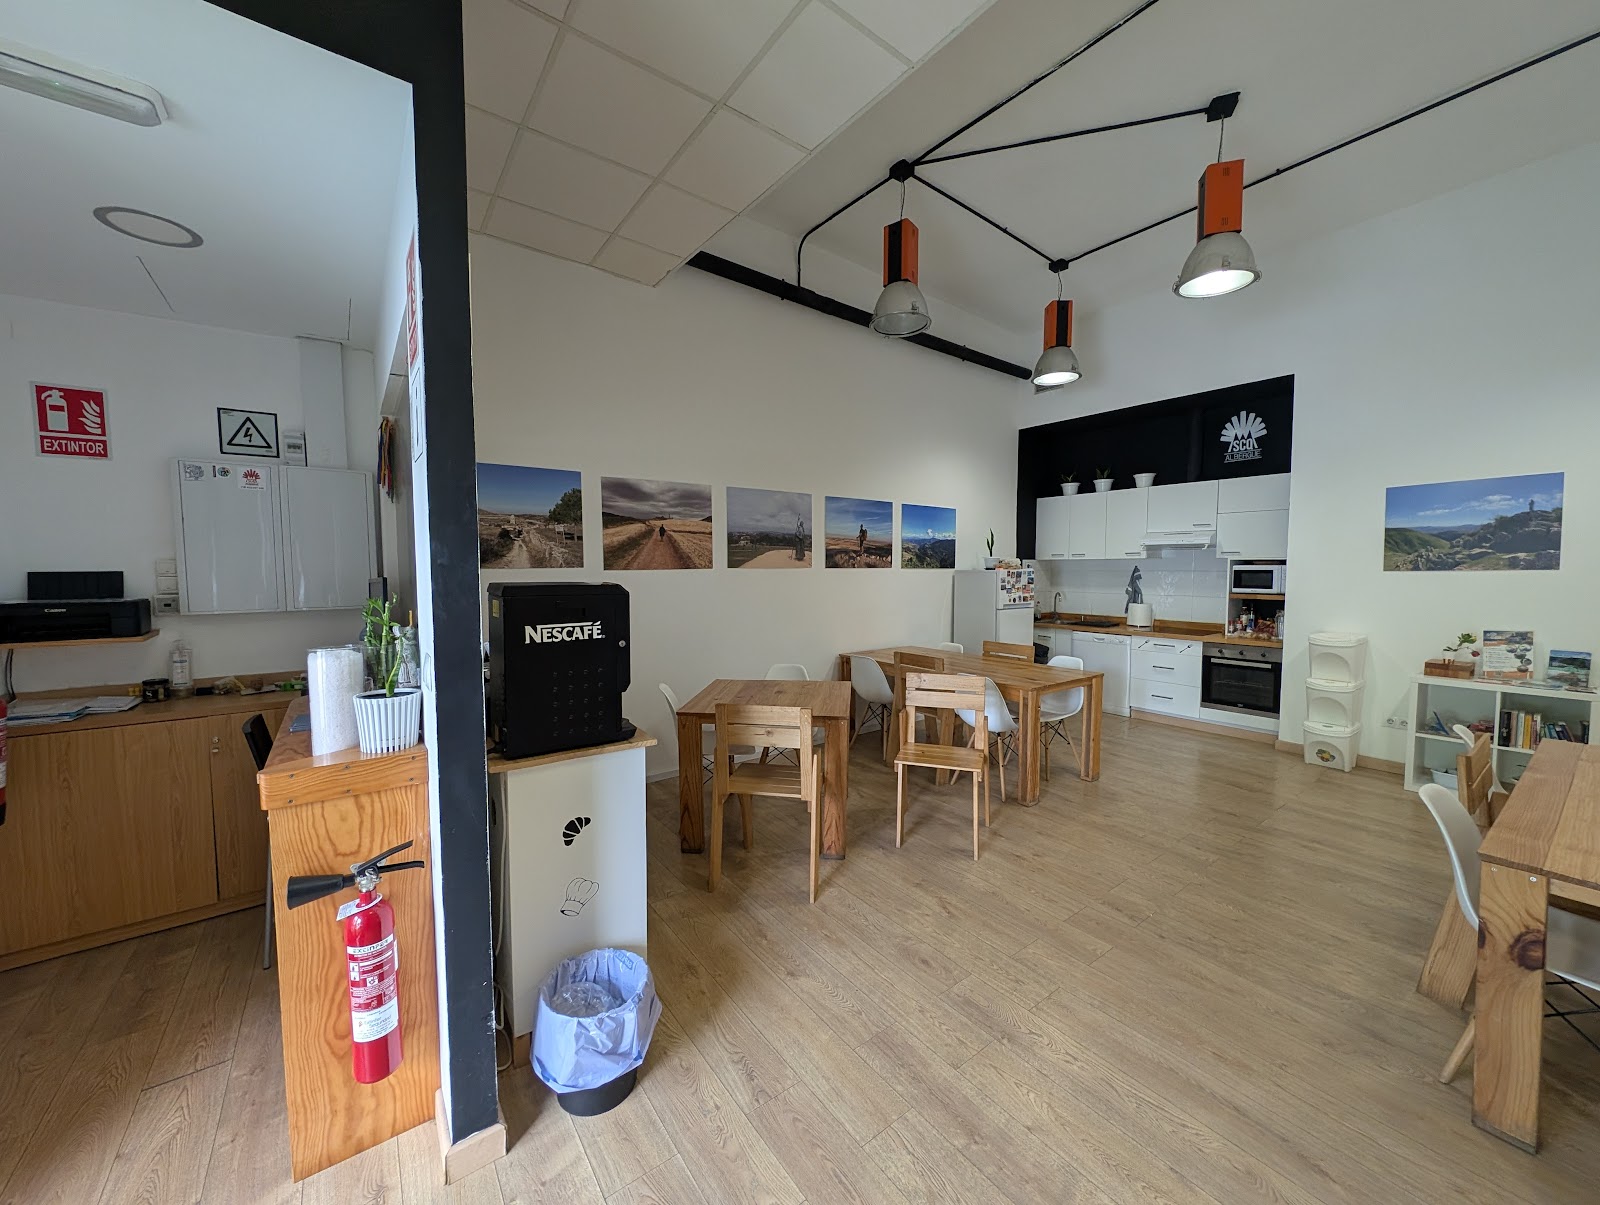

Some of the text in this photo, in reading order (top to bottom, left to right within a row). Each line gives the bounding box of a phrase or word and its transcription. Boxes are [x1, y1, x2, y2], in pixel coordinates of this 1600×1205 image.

[43, 439, 105, 455] EXTINTOR
[1232, 438, 1253, 452] SCQ
[1225, 450, 1261, 461] ALBERGUE
[524, 620, 603, 645] NESCAFÉ
